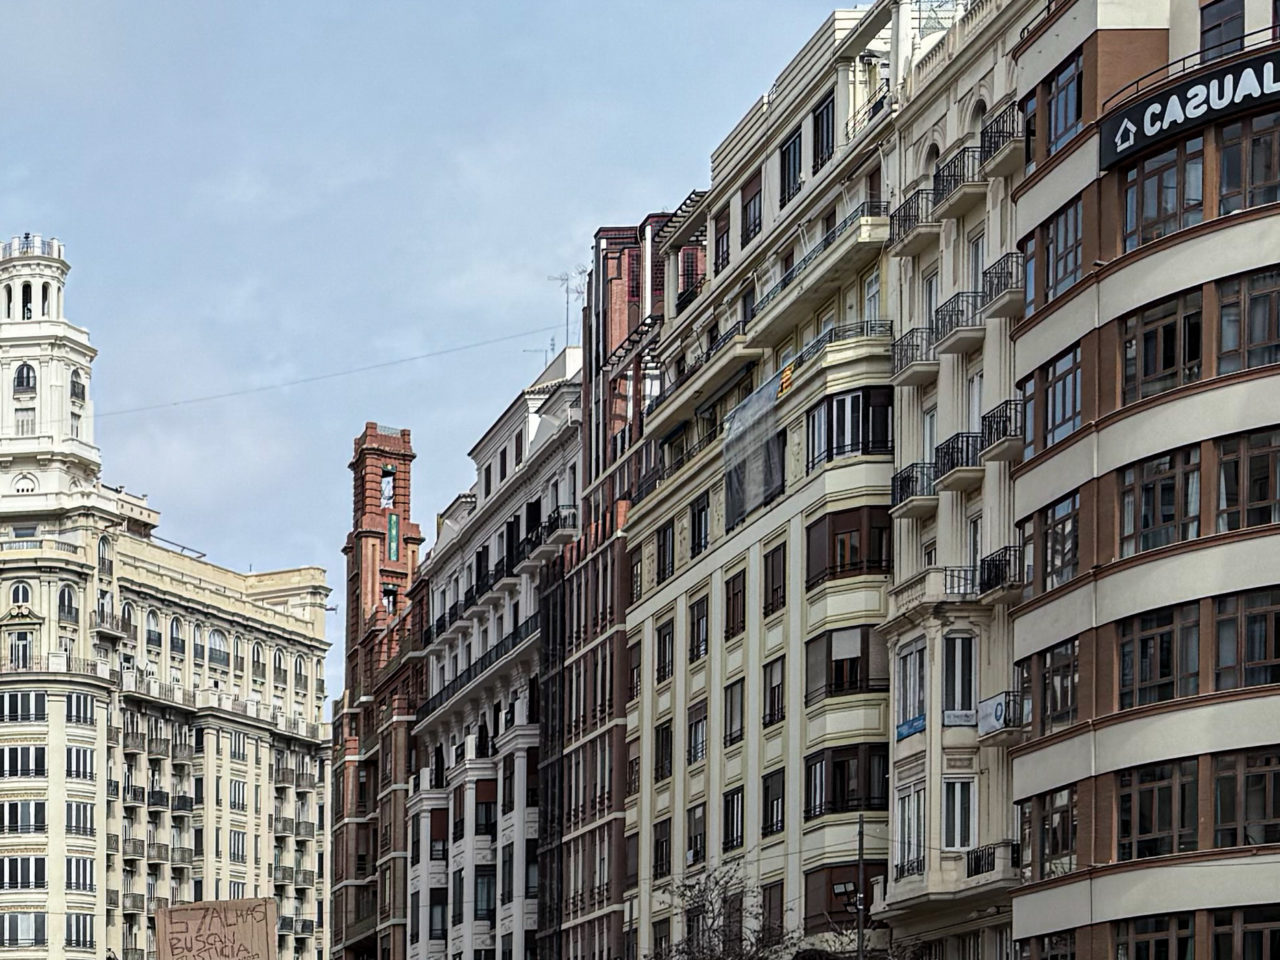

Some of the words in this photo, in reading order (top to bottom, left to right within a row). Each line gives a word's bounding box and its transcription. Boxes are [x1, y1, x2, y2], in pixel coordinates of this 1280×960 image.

[1143, 62, 1280, 137] CASUAL
[169, 907, 210, 934] 57
[169, 931, 236, 957] BUSCAN
